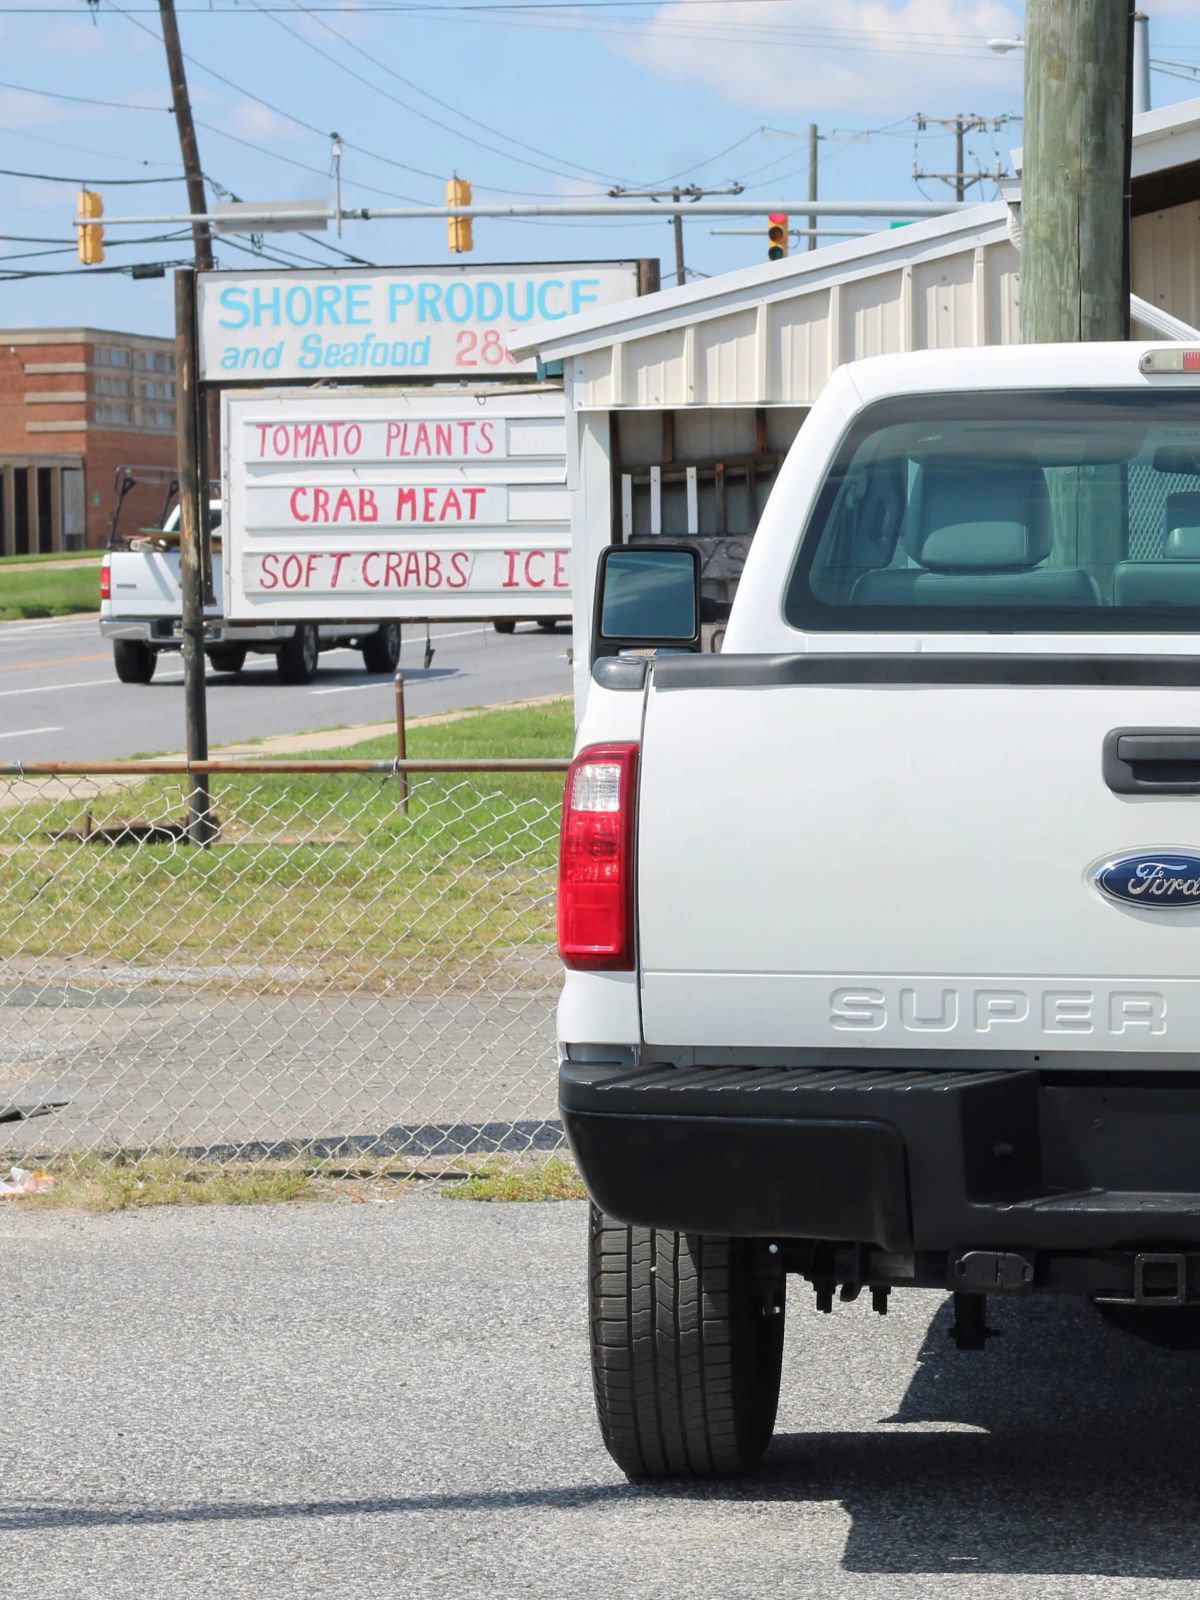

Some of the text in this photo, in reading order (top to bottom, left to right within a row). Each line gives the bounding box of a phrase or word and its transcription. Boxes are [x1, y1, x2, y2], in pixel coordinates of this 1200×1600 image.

[218, 284, 374, 329] SHORE
[220, 330, 517, 370] and Seafood 28
[256, 422, 495, 458] TOMATO PLANTS
[290, 488, 486, 523] CRAB MEAT
[259, 551, 569, 589] SOFT CRABS ICE
[828, 986, 1169, 1036] SUPER
